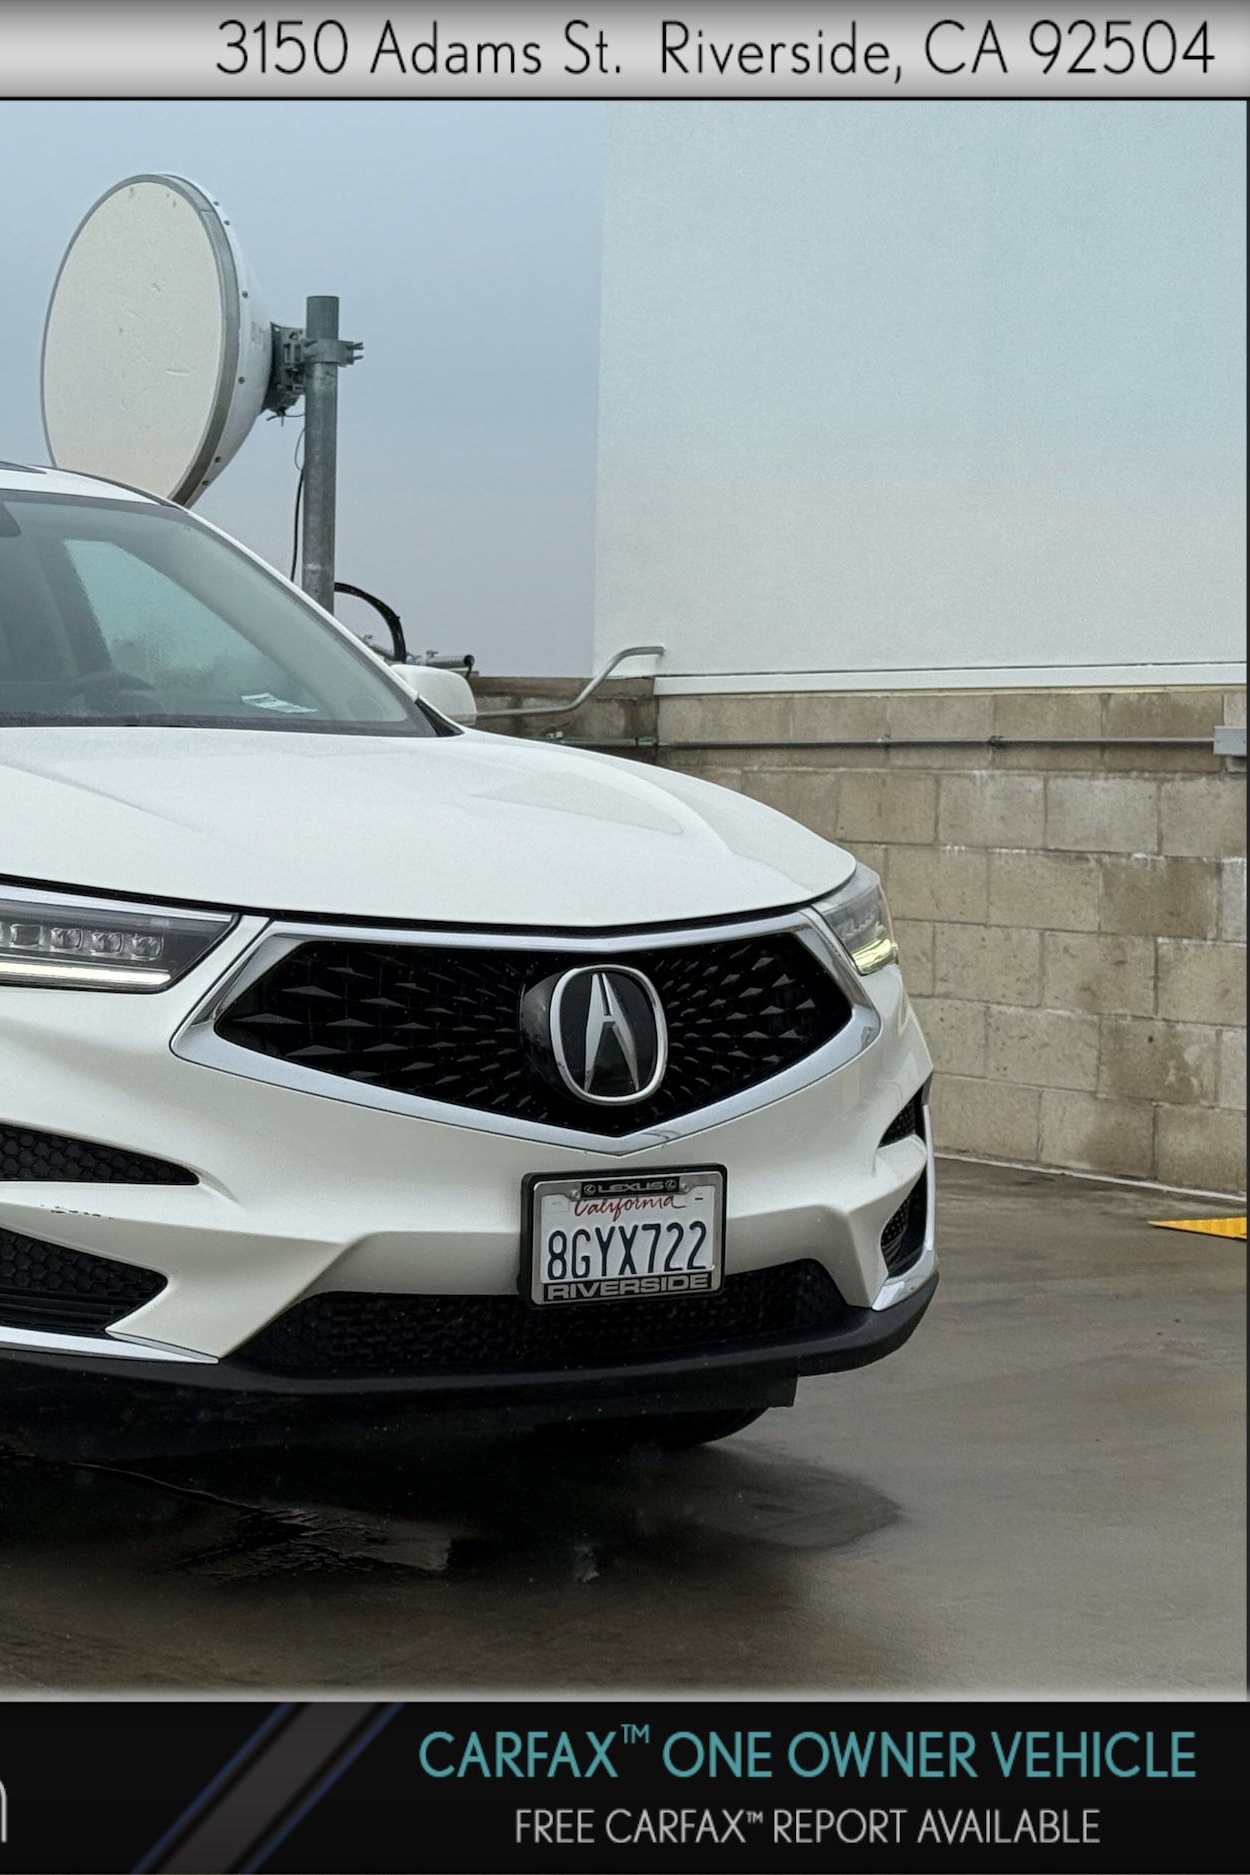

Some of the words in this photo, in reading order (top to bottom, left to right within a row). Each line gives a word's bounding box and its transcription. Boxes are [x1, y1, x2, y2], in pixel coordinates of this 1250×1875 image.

[597, 1181, 664, 1193] LEXUS
[573, 1193, 687, 1222] California
[547, 1220, 707, 1281] 8GYX722
[547, 1273, 709, 1300] RIVERSIDE
